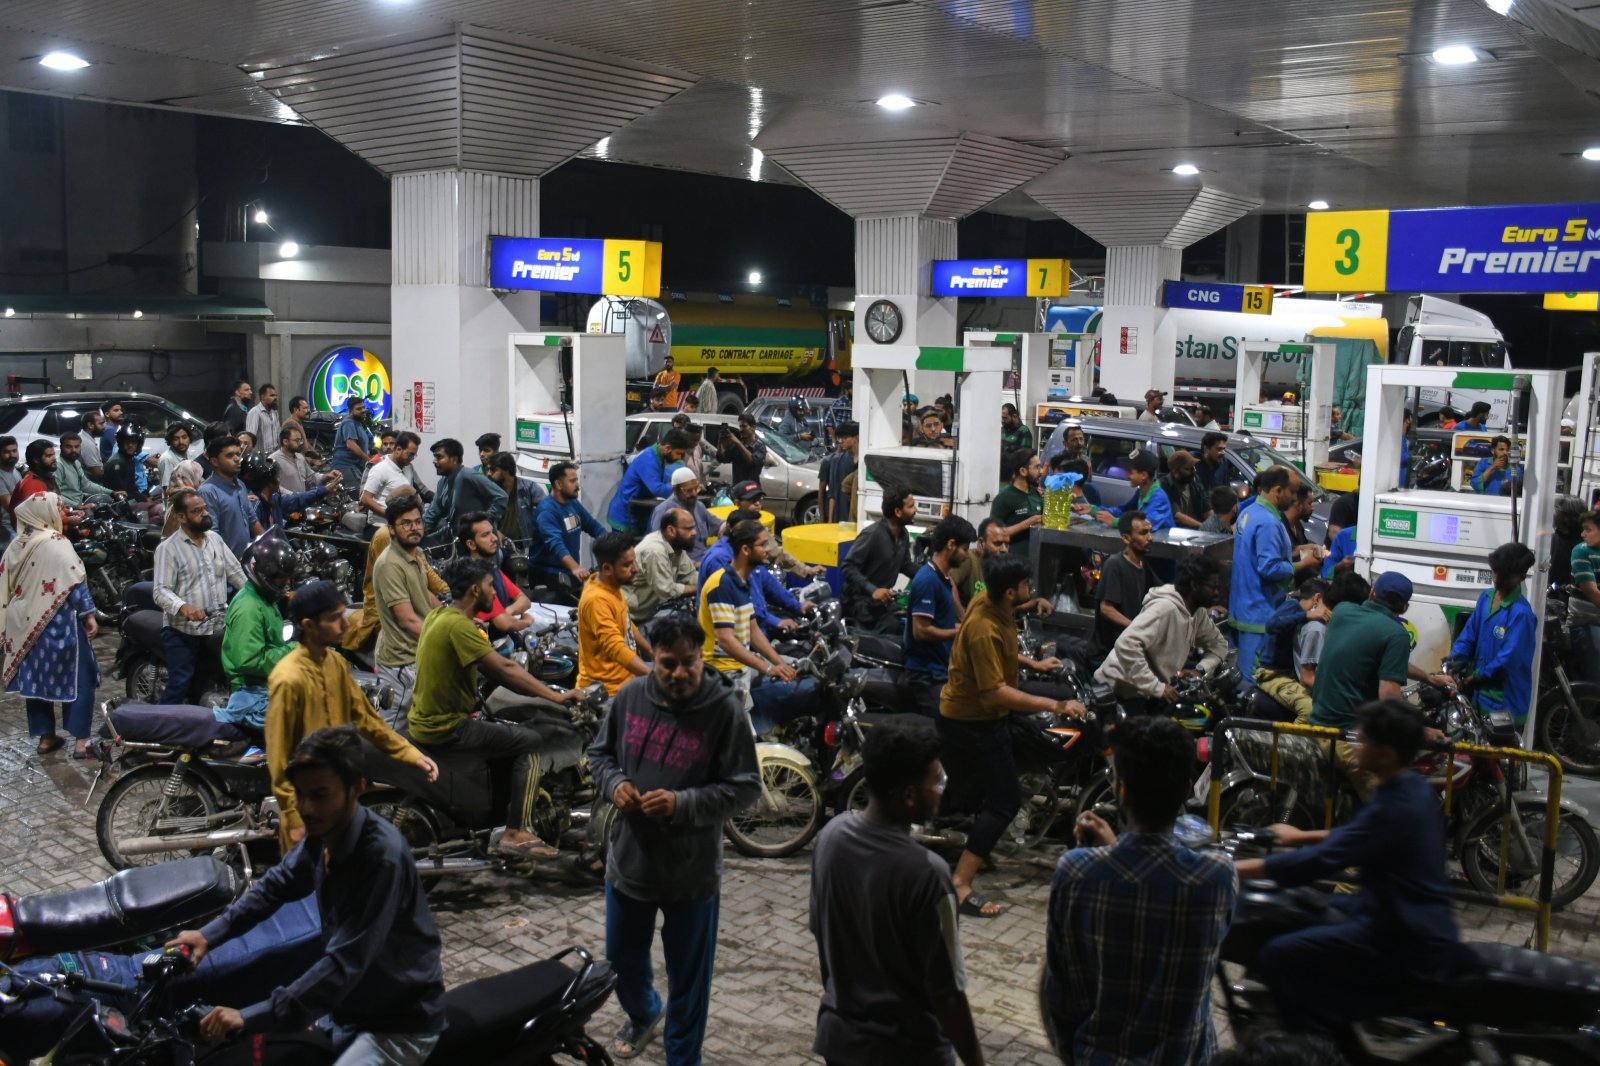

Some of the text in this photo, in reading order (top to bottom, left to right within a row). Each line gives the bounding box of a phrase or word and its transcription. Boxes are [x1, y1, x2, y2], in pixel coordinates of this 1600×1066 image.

[1501, 219, 1588, 243] Euro 5
[537, 247, 573, 262] Euro 5
[1334, 228, 1361, 276] 3
[1438, 246, 1600, 274] Premier
[511, 260, 580, 281] Premier
[618, 250, 631, 282] 5
[950, 275, 1009, 289] Premier
[1038, 268, 1048, 290] 7
[1187, 289, 1221, 303] CNG
[1246, 291, 1263, 310] 15
[701, 349, 716, 360] PSO
[719, 349, 757, 360] CONTRACT
[759, 350, 794, 360] CARRIAGE
[1175, 334, 1219, 360] stan
[331, 373, 382, 404] PSO
